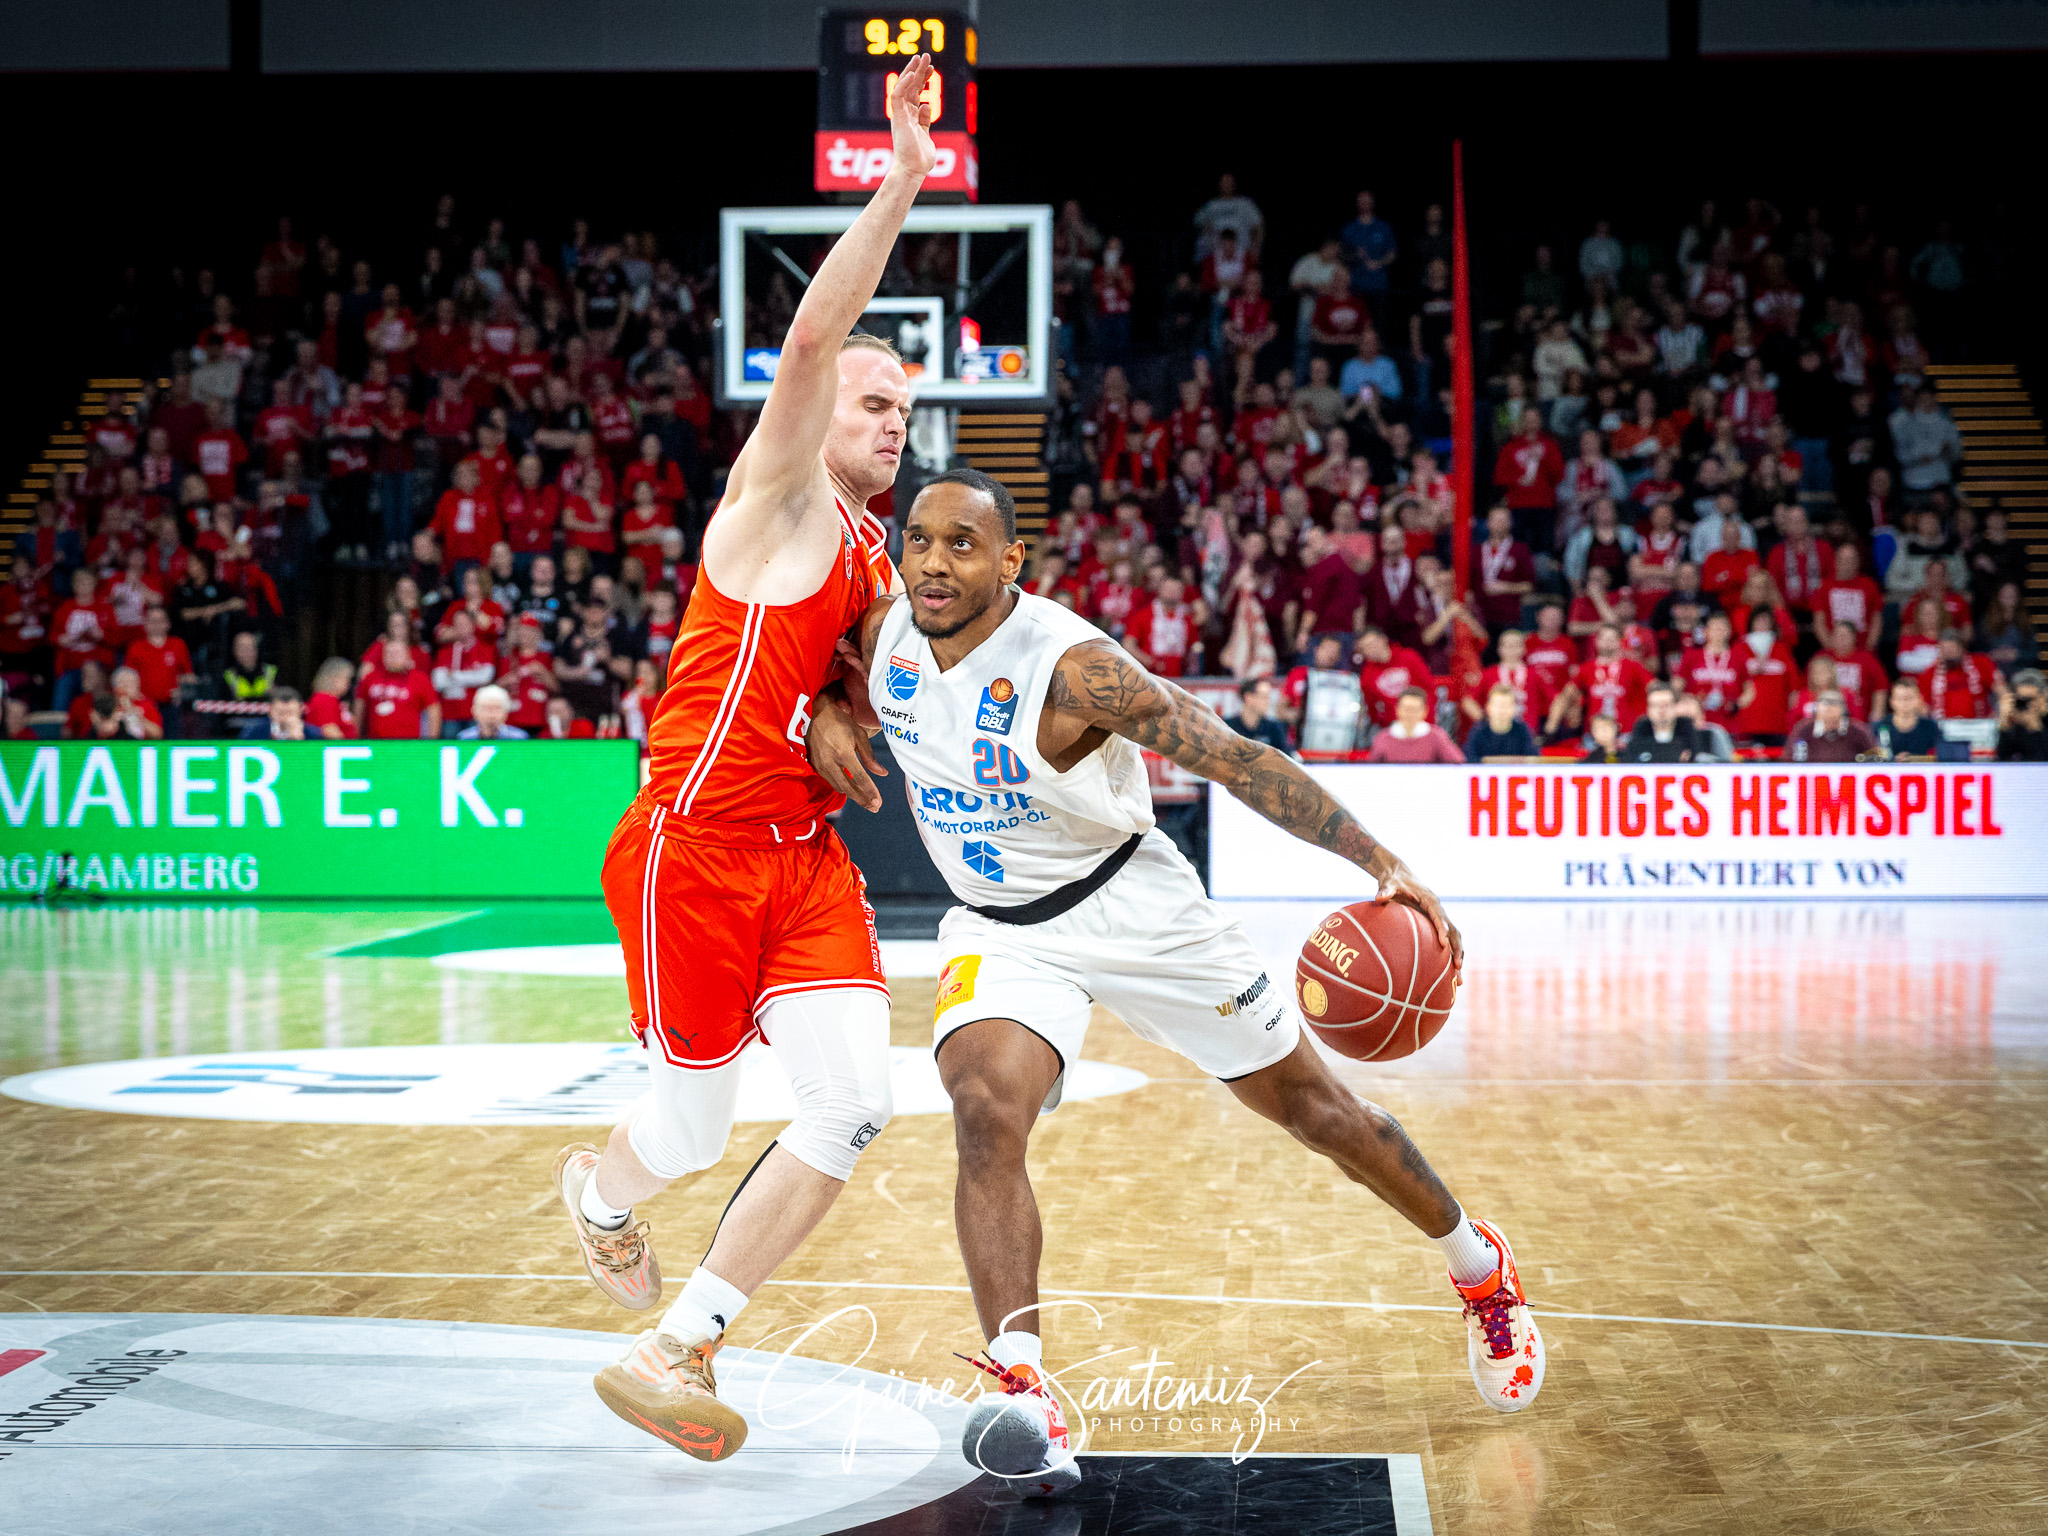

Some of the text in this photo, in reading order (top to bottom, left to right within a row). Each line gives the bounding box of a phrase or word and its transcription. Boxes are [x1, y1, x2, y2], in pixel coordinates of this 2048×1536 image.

[864, 19, 945, 55] 9.27
[826, 139, 956, 184] tipo
[881, 706, 909, 721] CRAFT
[979, 714, 1005, 732] BBL
[972, 738, 1031, 787] 20
[322, 745, 399, 828] E.
[439, 745, 525, 828] K.
[1468, 773, 2003, 837] HEUTIGES HEIMSPIEL
[1563, 853, 1907, 888] PRÄSENTIERT VON
